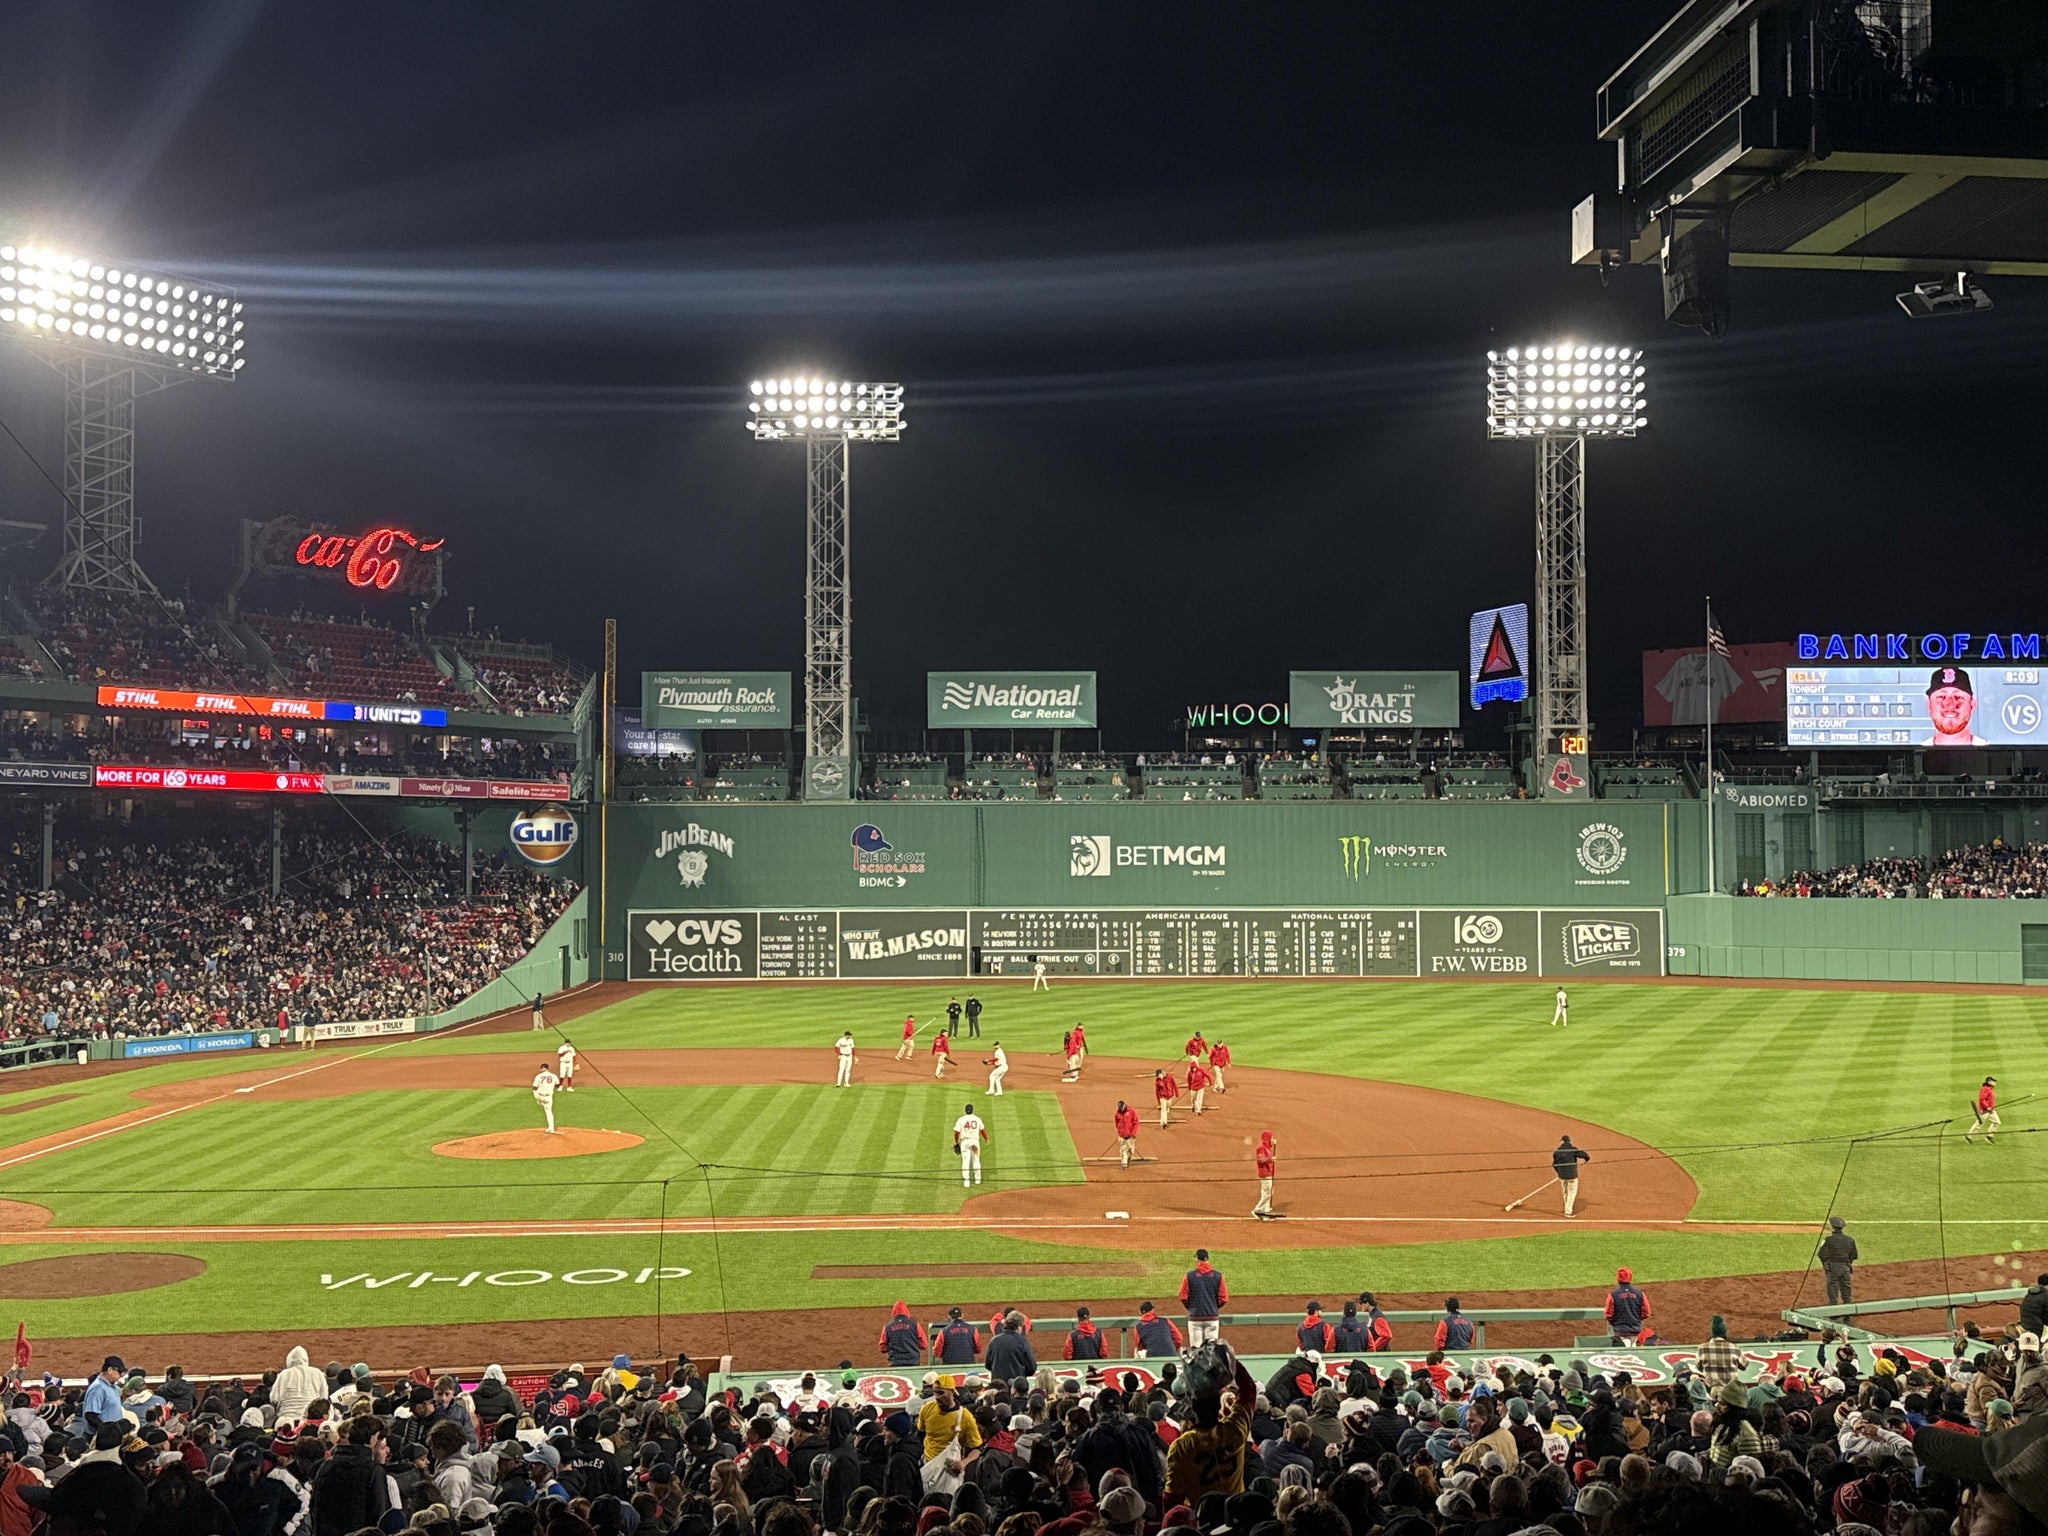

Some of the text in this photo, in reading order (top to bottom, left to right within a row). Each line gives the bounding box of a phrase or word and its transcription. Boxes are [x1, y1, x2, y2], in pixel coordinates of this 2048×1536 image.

[1798, 633, 2048, 660] BANK OF AM
[653, 677, 670, 685] More
[672, 677, 687, 685] Than
[1790, 671, 1827, 683] KELLY
[2005, 671, 2033, 683] 8:09
[974, 684, 1081, 707] National
[1790, 685, 1826, 694] TONIGHT
[114, 691, 159, 705] STIHL
[658, 687, 776, 706] Plymouth Rock
[1330, 692, 1415, 712] DRAFT
[194, 696, 238, 710] STIHL
[270, 701, 310, 715] STIHL
[368, 706, 421, 723] UNITED
[1010, 709, 1076, 719] Car Rental
[1186, 702, 1289, 727] WHOO
[1340, 708, 1413, 724] KINGS
[1823, 706, 1829, 715] 0
[1847, 706, 1854, 715] 0
[1872, 706, 1878, 715] 0
[1897, 706, 1904, 715] 0
[2007, 705, 2036, 726] VS
[1791, 719, 1847, 728] PITCH COUNT
[623, 730, 681, 740] Your al-star
[1818, 732, 1825, 741] 4
[1864, 732, 1871, 741] 3
[627, 741, 648, 750] care
[1561, 737, 1586, 754] 1:20
[0, 768, 88, 780] NEYARD VINES
[96, 771, 133, 783] MORE
[136, 773, 159, 784] FOR
[189, 774, 226, 785] YEARS
[292, 777, 324, 788] F.W. W
[418, 783, 471, 793] Ninety Nine
[492, 786, 530, 796] Safelite
[1739, 795, 1808, 807] ABIOMED
[513, 822, 574, 842] Gulf
[1578, 822, 1624, 840] IBEW 103
[859, 852, 925, 863] RED SOX
[1116, 845, 1226, 866] BETMGM
[1585, 847, 1627, 875] CONTRACTORS
[859, 863, 925, 873] SCHOLARS
[859, 877, 894, 887] BIDMC
[677, 919, 742, 945] CVS
[842, 931, 880, 940] WHO BUT
[1455, 915, 1503, 945] 160
[1577, 924, 1630, 944] ACE
[1579, 941, 1631, 957] TICKET
[1667, 947, 1686, 957] 379
[607, 952, 624, 963] 310
[648, 948, 743, 973] Health
[917, 953, 942, 961] SINCE
[1011, 955, 1028, 963] BALL
[1063, 955, 1079, 963] OUT
[991, 962, 1001, 974] 14
[1432, 956, 1528, 972] F.W. WEBB
[334, 1025, 356, 1034] TRULY
[382, 1021, 403, 1030] TRULY
[142, 1043, 183, 1053] HONDA
[207, 1038, 246, 1047] HONDA
[540, 1076, 552, 1084] 78
[964, 1120, 977, 1130] 40
[320, 1267, 692, 1290] WHOOP
